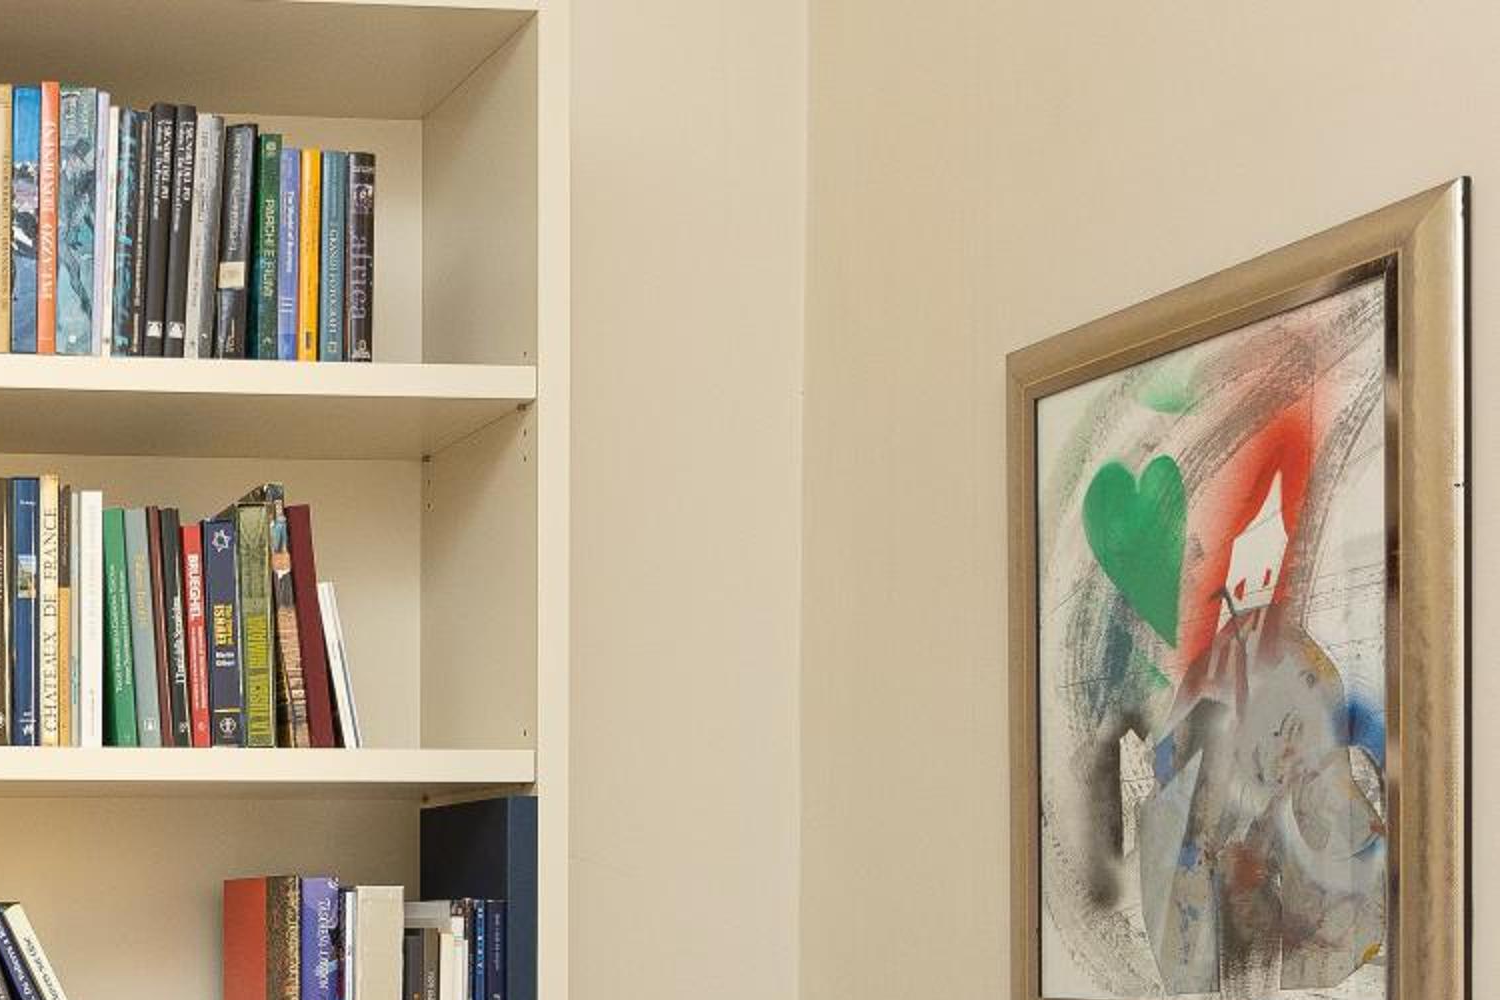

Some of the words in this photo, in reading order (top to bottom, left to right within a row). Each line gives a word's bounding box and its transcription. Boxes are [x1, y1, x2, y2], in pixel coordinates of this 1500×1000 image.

[44, 507, 57, 581] FRANCE
[44, 592, 57, 617] DE
[187, 554, 203, 622] BRUEGHEL
[214, 604, 226, 647] ISRAEL
